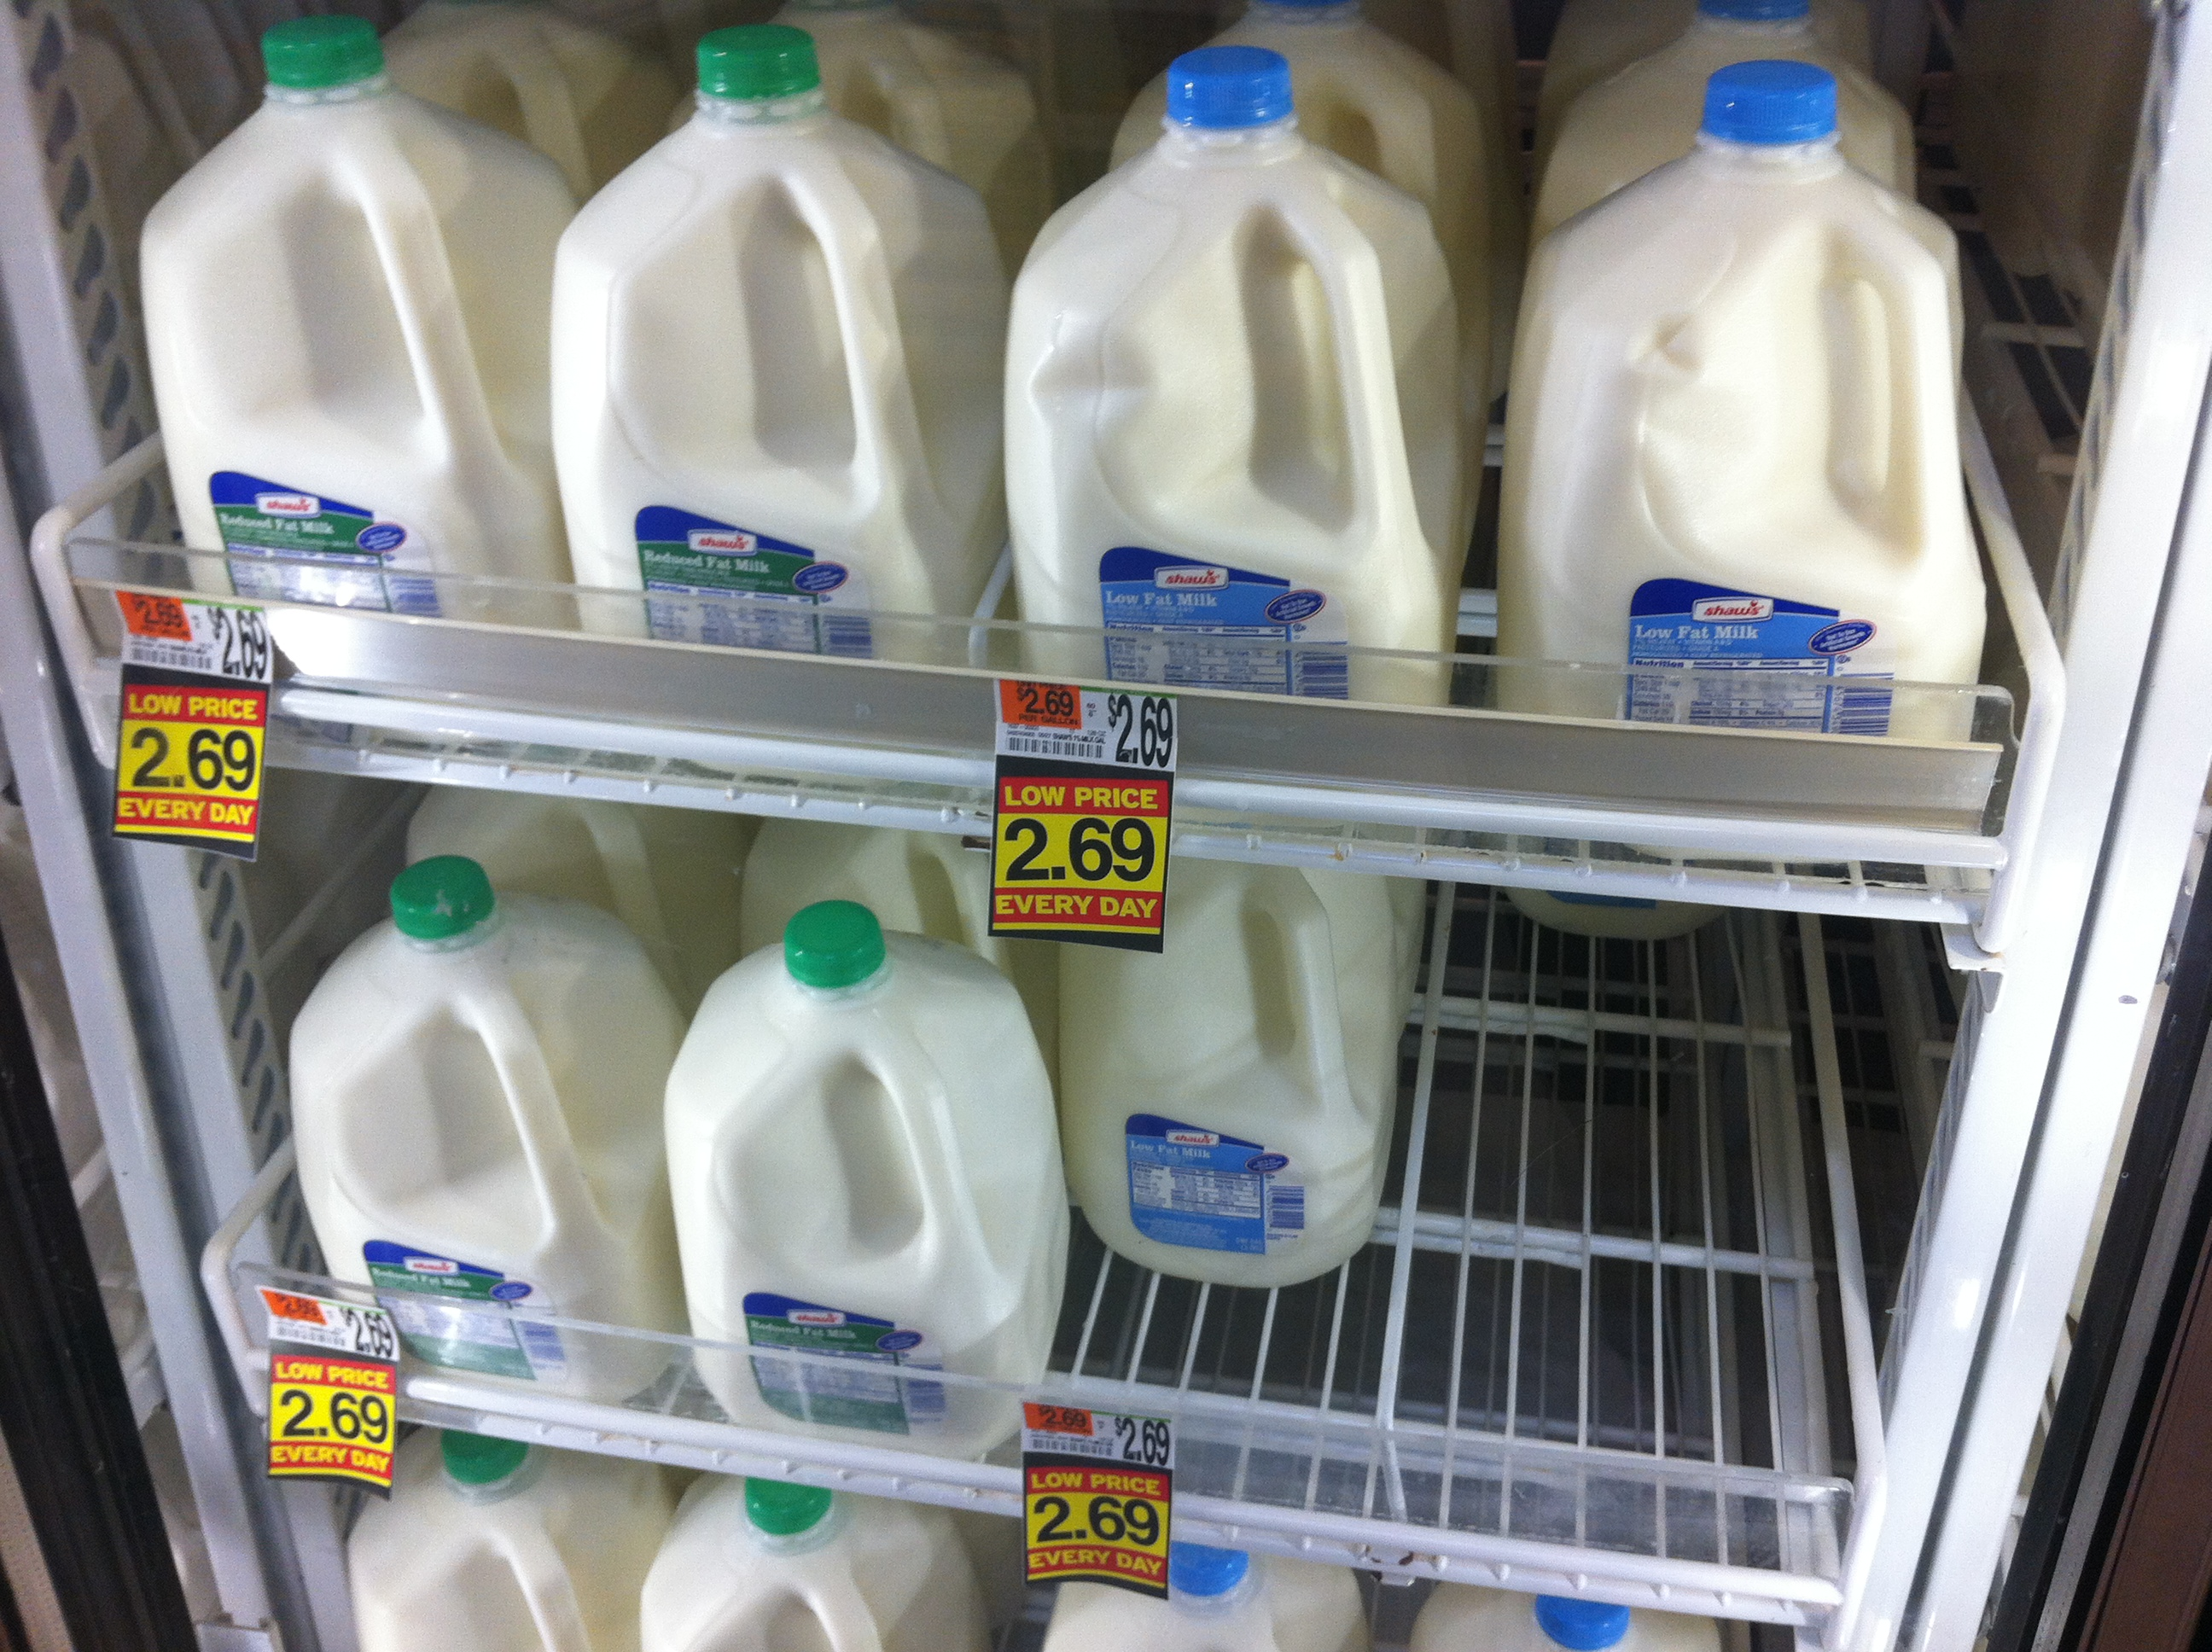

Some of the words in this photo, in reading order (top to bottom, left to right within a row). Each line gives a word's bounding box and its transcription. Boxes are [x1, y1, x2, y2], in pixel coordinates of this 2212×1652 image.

[1106, 590, 1139, 604] Low
[1144, 591, 1173, 606] Fat
[1177, 593, 1218, 607] Milk
[1634, 625, 1674, 638] Low
[1678, 625, 1709, 638] Fat
[1714, 625, 1760, 638] Milk
[128, 693, 182, 716] LOW
[189, 696, 259, 720] PRICE
[1108, 692, 1174, 768] $2.69
[131, 726, 257, 792] 2.69
[118, 796, 207, 821] EVERY
[210, 802, 255, 826] DAY
[1004, 785, 1066, 807] LOW
[1074, 786, 1159, 810] PRICE
[1004, 817, 1155, 883] 2.69
[995, 894, 1095, 916] EVERY
[1100, 897, 1158, 919] DAY
[1182, 1148, 1211, 1159] Milk
[276, 1362, 323, 1381] LOW
[328, 1365, 389, 1389] PRICE
[281, 1388, 388, 1444] 2.69
[1115, 1416, 1170, 1467] $2.69
[271, 1446, 347, 1463] EVERY
[352, 1449, 390, 1473] DAY
[1031, 1472, 1083, 1489] LOW
[1090, 1474, 1161, 1496] PRICE
[1033, 1496, 1161, 1547] 2.69
[1028, 1549, 1112, 1569] EVERY
[1115, 1551, 1162, 1576] DAY
